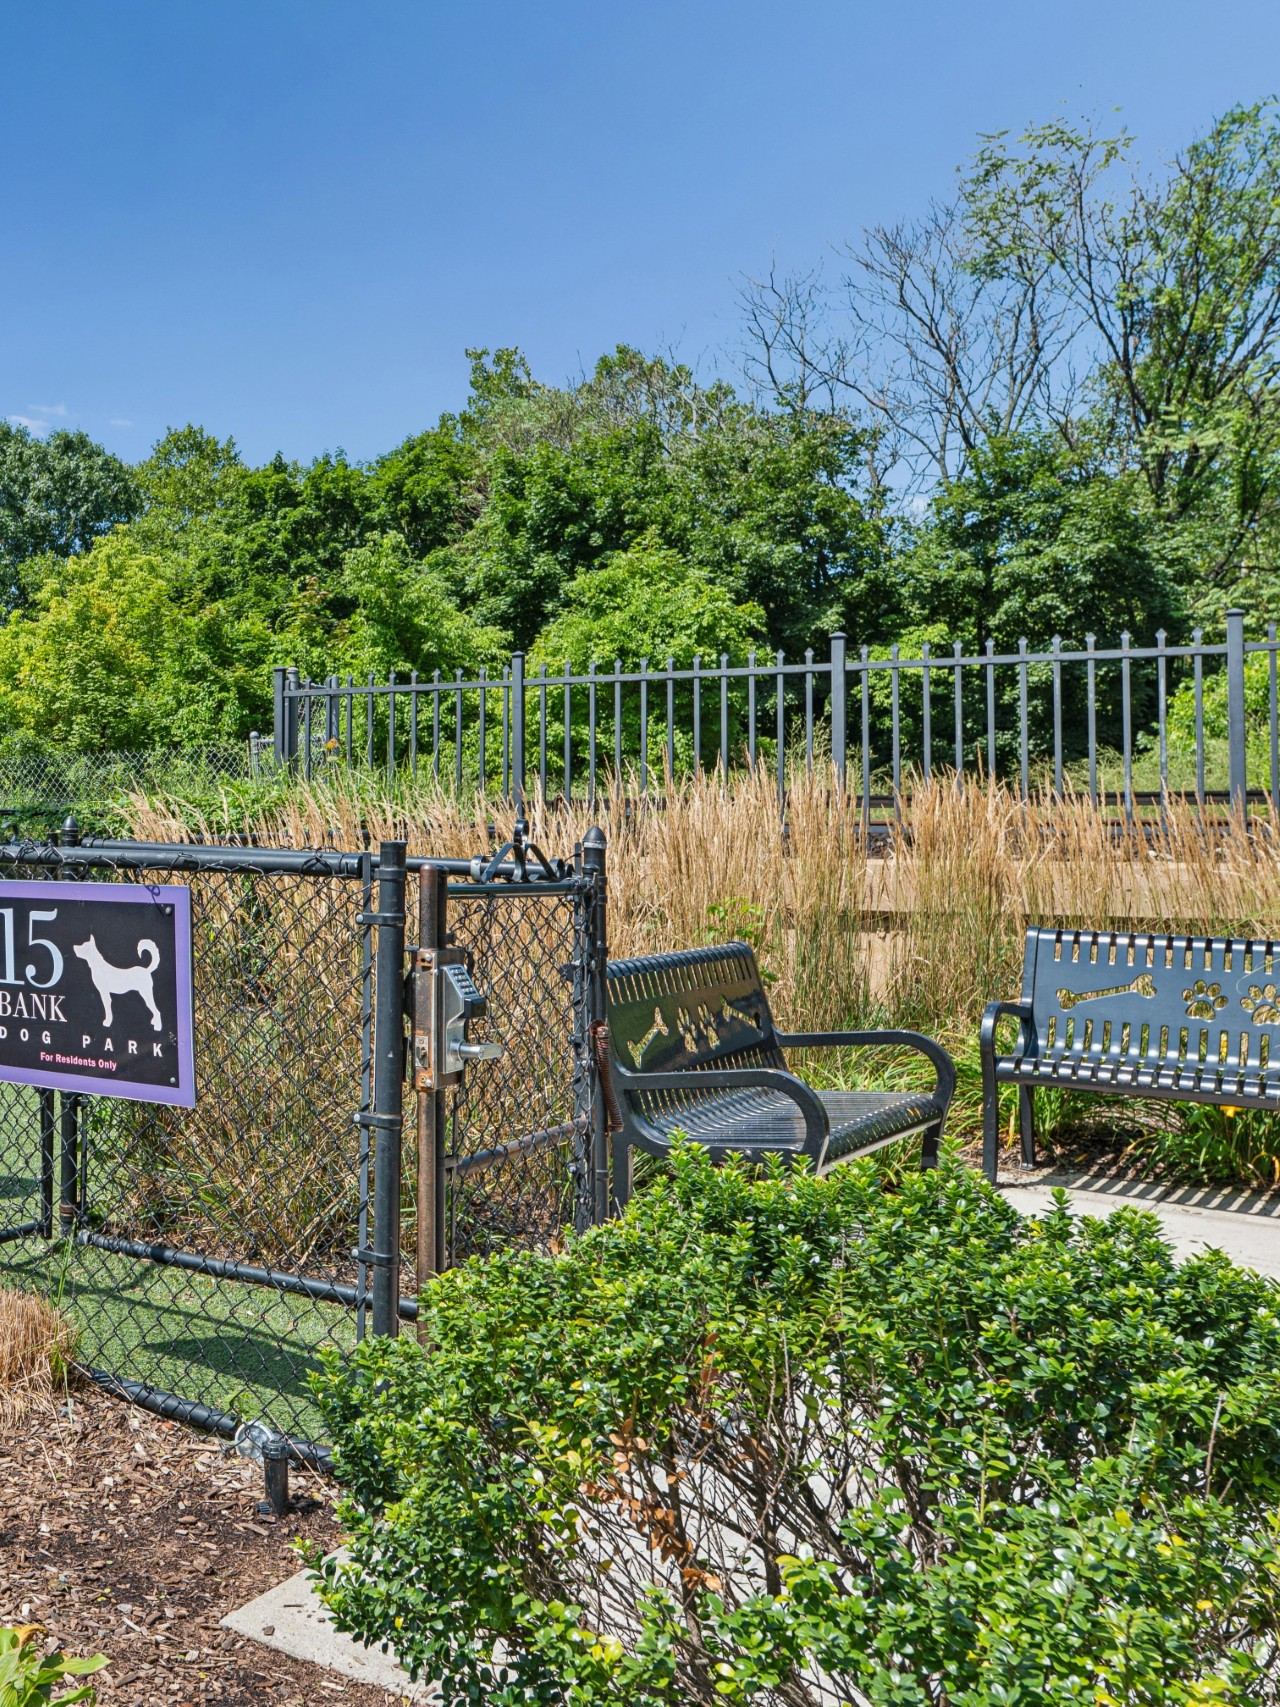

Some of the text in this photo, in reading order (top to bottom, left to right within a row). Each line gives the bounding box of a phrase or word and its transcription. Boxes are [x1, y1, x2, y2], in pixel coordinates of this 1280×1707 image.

[0, 1025, 163, 1057] DOG PARK
[40, 1052, 117, 1071] For Residents Only
